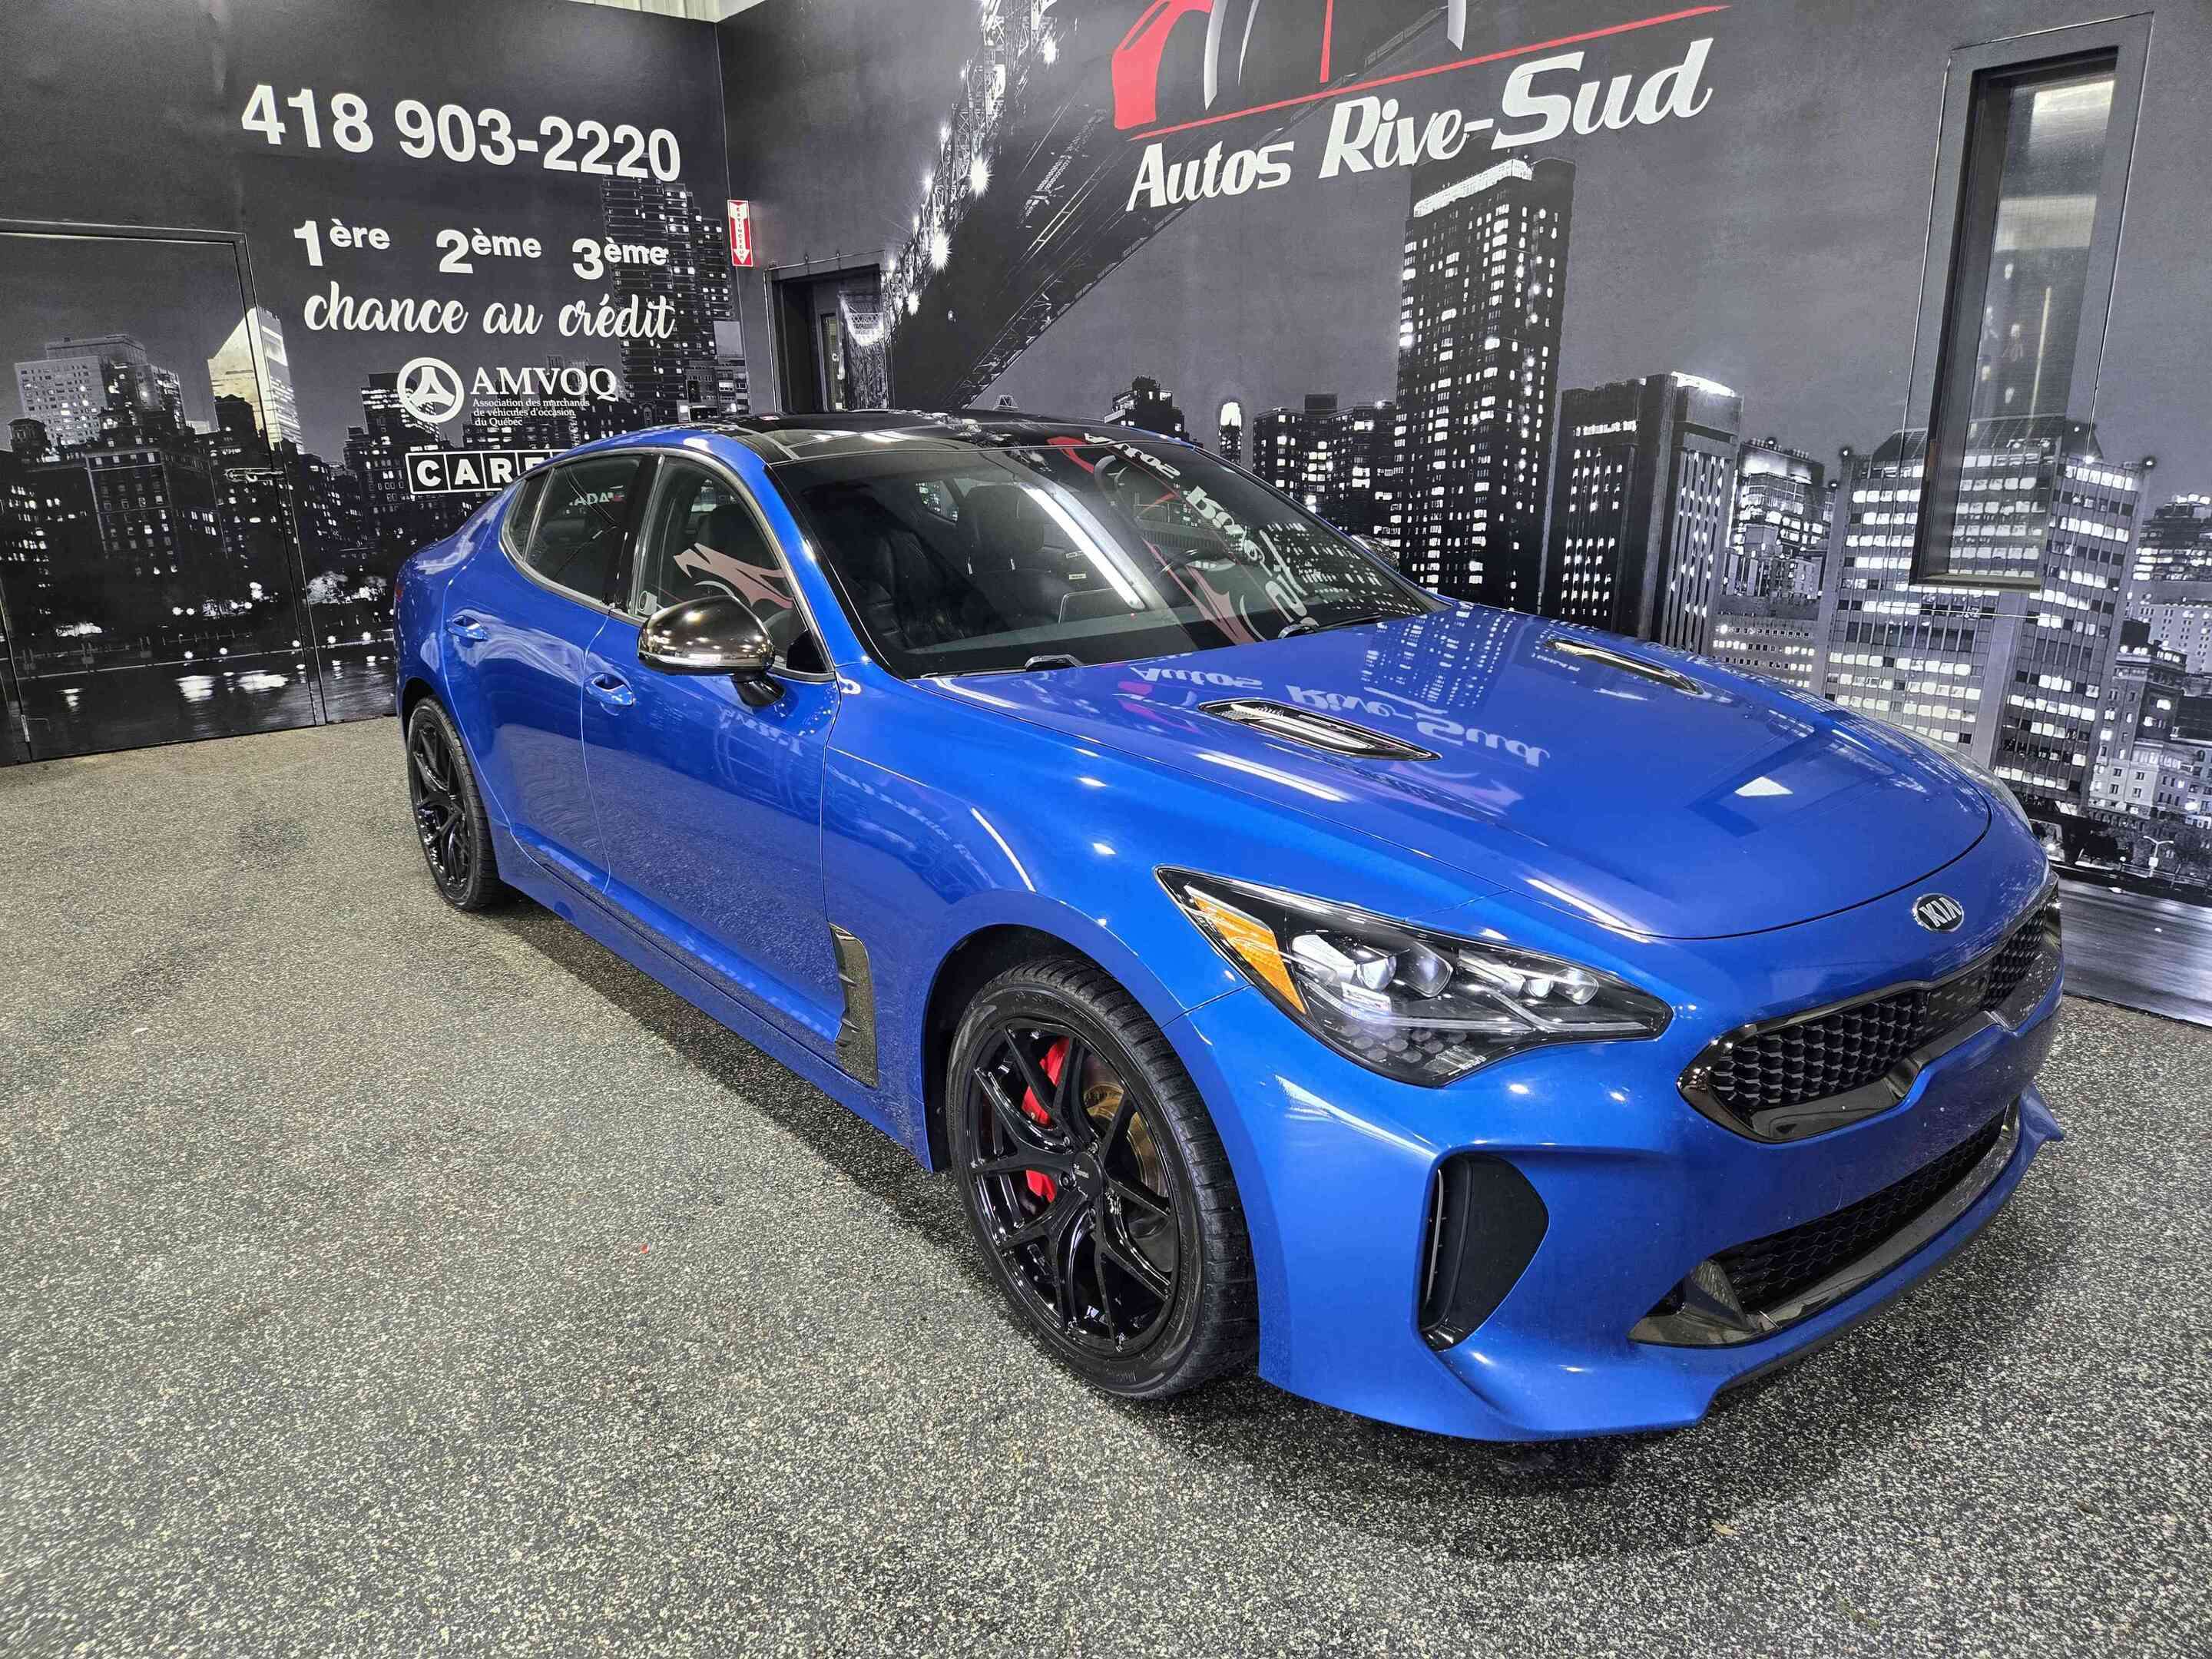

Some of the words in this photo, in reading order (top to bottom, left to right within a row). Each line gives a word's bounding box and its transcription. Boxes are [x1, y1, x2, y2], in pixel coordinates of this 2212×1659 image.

[241, 84, 374, 154] 418
[394, 99, 681, 182] 903-2220
[1126, 142, 1294, 212] Autos
[1318, 37, 1714, 179] Rive-Sud
[293, 218, 391, 267] 1ère
[435, 228, 542, 274] 2ème
[572, 237, 670, 280] 3ème
[303, 282, 470, 333] chance
[482, 302, 545, 335] au
[558, 295, 676, 339] crédit
[470, 366, 619, 402] AMVOQ
[472, 398, 524, 407] Association
[525, 399, 541, 407] des
[542, 399, 591, 408] marchands
[473, 408, 485, 417] de
[487, 407, 528, 417] véhicules
[530, 408, 575, 416] d'occasion
[475, 418, 487, 426] du
[489, 417, 523, 427] Québec
[1918, 896, 1962, 928] KIA
